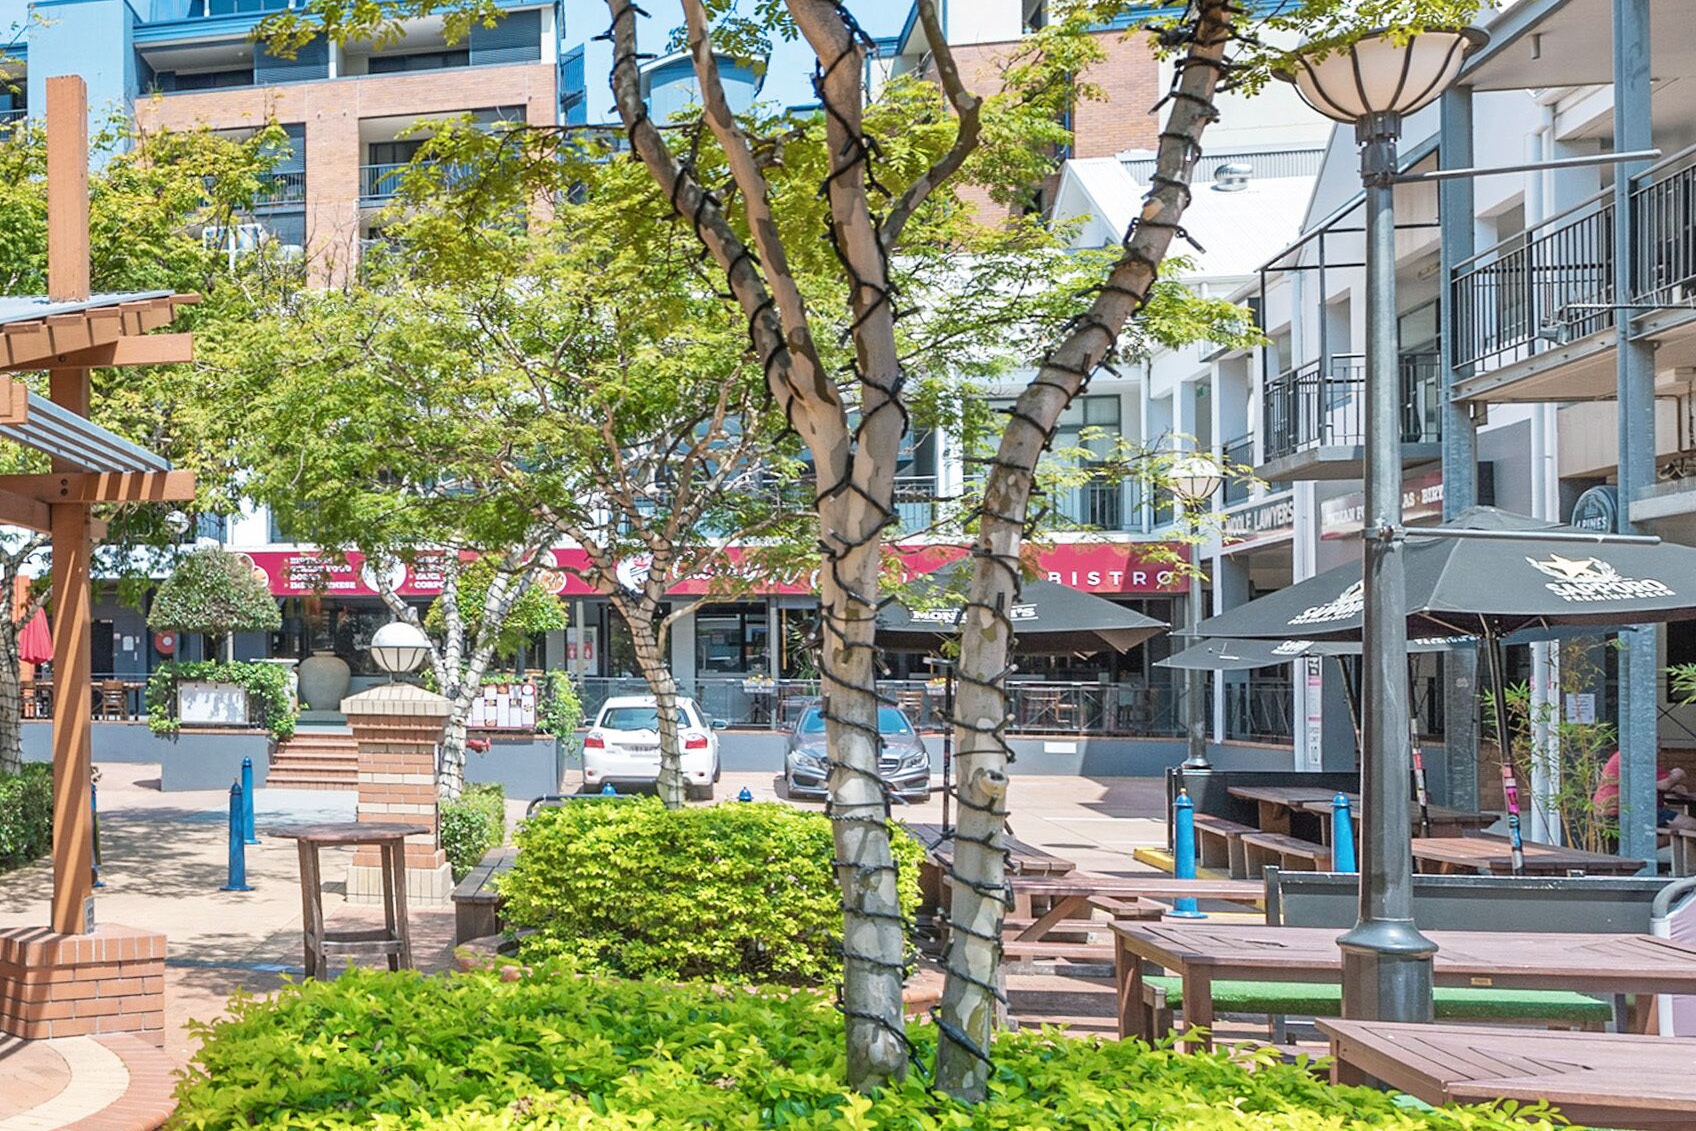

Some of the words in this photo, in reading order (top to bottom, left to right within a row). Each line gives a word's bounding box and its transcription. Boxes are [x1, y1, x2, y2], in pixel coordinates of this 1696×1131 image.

[1254, 500, 1294, 531] LAWYERS
[1048, 571, 1173, 586] BISTRO
[1545, 579, 1668, 597] SAPPORO
[1562, 593, 1635, 602] PREMIUM
[1635, 589, 1677, 598] BEER
